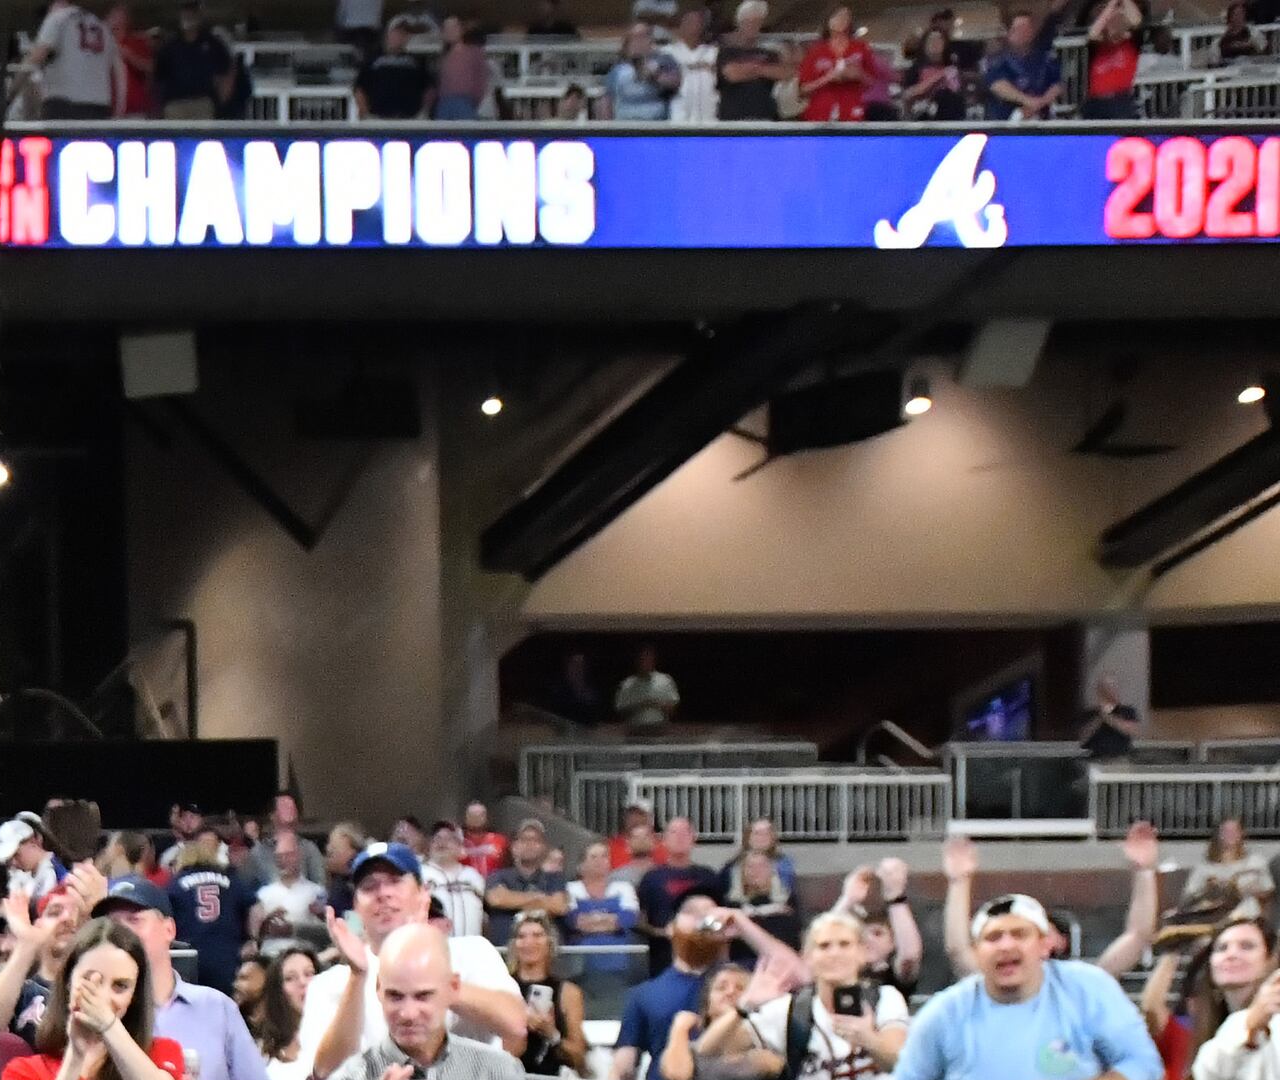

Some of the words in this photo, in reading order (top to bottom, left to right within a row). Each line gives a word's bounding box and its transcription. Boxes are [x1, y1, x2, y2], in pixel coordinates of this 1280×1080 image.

[58, 141, 596, 246] CHAMPIONS
[1104, 136, 1280, 239] 2021
[196, 884, 221, 923] 5
